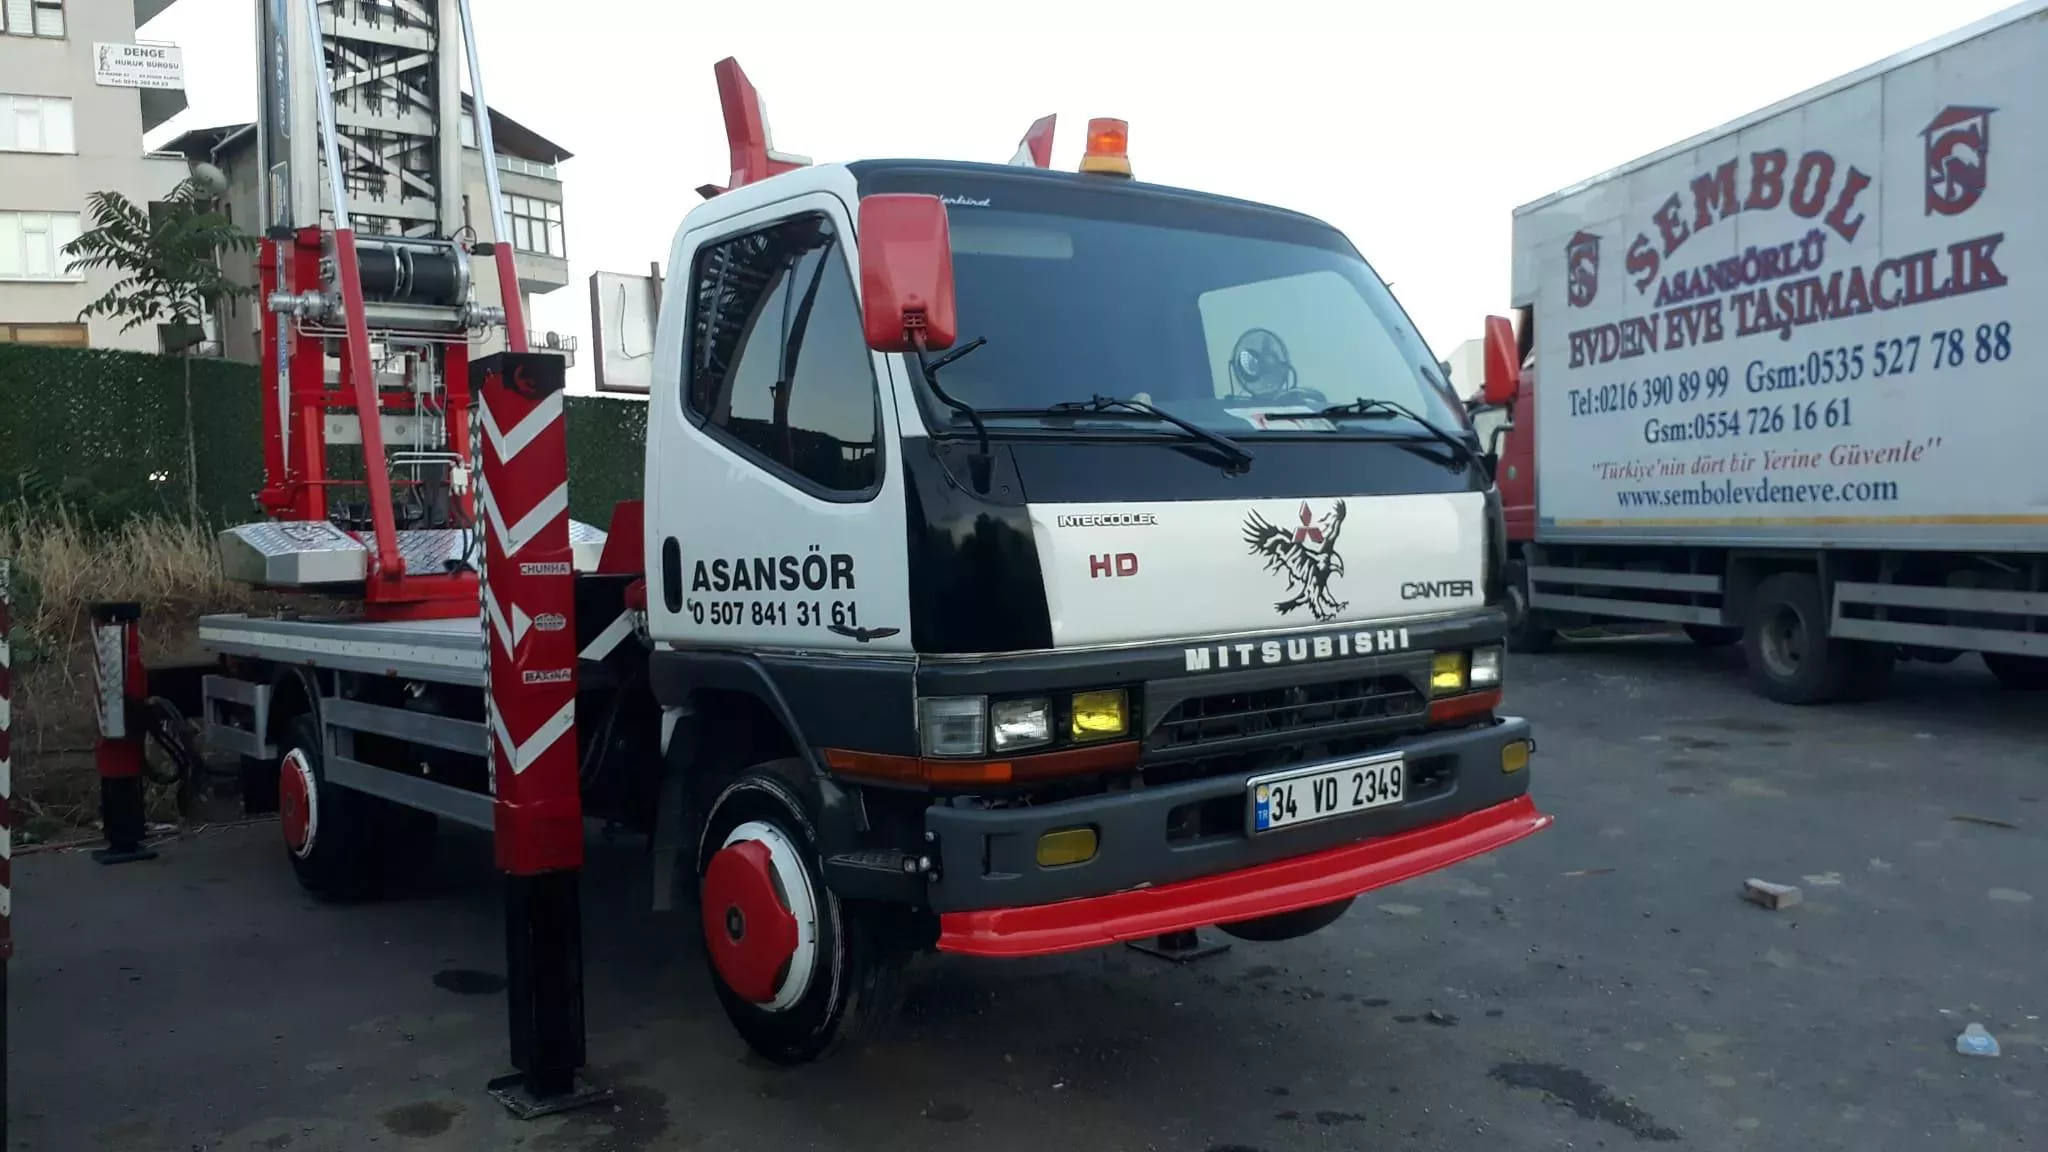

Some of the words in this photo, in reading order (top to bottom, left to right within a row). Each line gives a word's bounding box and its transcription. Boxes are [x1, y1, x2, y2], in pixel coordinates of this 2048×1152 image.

[115, 59, 143, 68] HUKUK
[124, 47, 165, 58] DENGE
[1625, 148, 1871, 295] SEMBOL
[1654, 228, 1827, 307] ASANSÖRLÜ
[1568, 314, 1660, 369] EVDEN
[1664, 299, 1724, 350] EVE
[1730, 232, 2008, 341] TAŞIMACILIK
[1569, 379, 1638, 417] Tel:0216
[1642, 375, 1673, 408] 390
[1679, 370, 1700, 402] 89
[1706, 366, 1729, 398] 99
[1746, 345, 1864, 393] Gsm:0535
[1873, 336, 1921, 377] 527
[1931, 328, 1964, 369] 78
[1975, 320, 2011, 363] 88
[1644, 409, 1740, 443] Gsm:0554
[1748, 404, 1784, 435] 726
[1792, 401, 1817, 431] 16
[1825, 396, 1851, 428] 61
[1691, 455, 1727, 475] dört
[1730, 452, 1756, 472] bir
[1762, 447, 1822, 471] Yerine
[1616, 475, 1898, 507] www.sembolevdeneve.com
[1057, 513, 1159, 528] INTERCOOLER
[692, 544, 855, 592] ASANSÖR
[1089, 552, 1139, 578] HD
[1400, 580, 1473, 600] CANTER
[694, 602, 704, 625] 0
[711, 601, 743, 625] 507
[752, 601, 786, 626] 841
[797, 601, 821, 626] 31
[832, 600, 857, 626] 61
[1185, 628, 1410, 672] MITSUBISHI
[1272, 784, 1297, 821] 34
[1313, 776, 1338, 813] VD
[1352, 765, 1401, 806] 2349
[1257, 810, 1268, 820] TR
